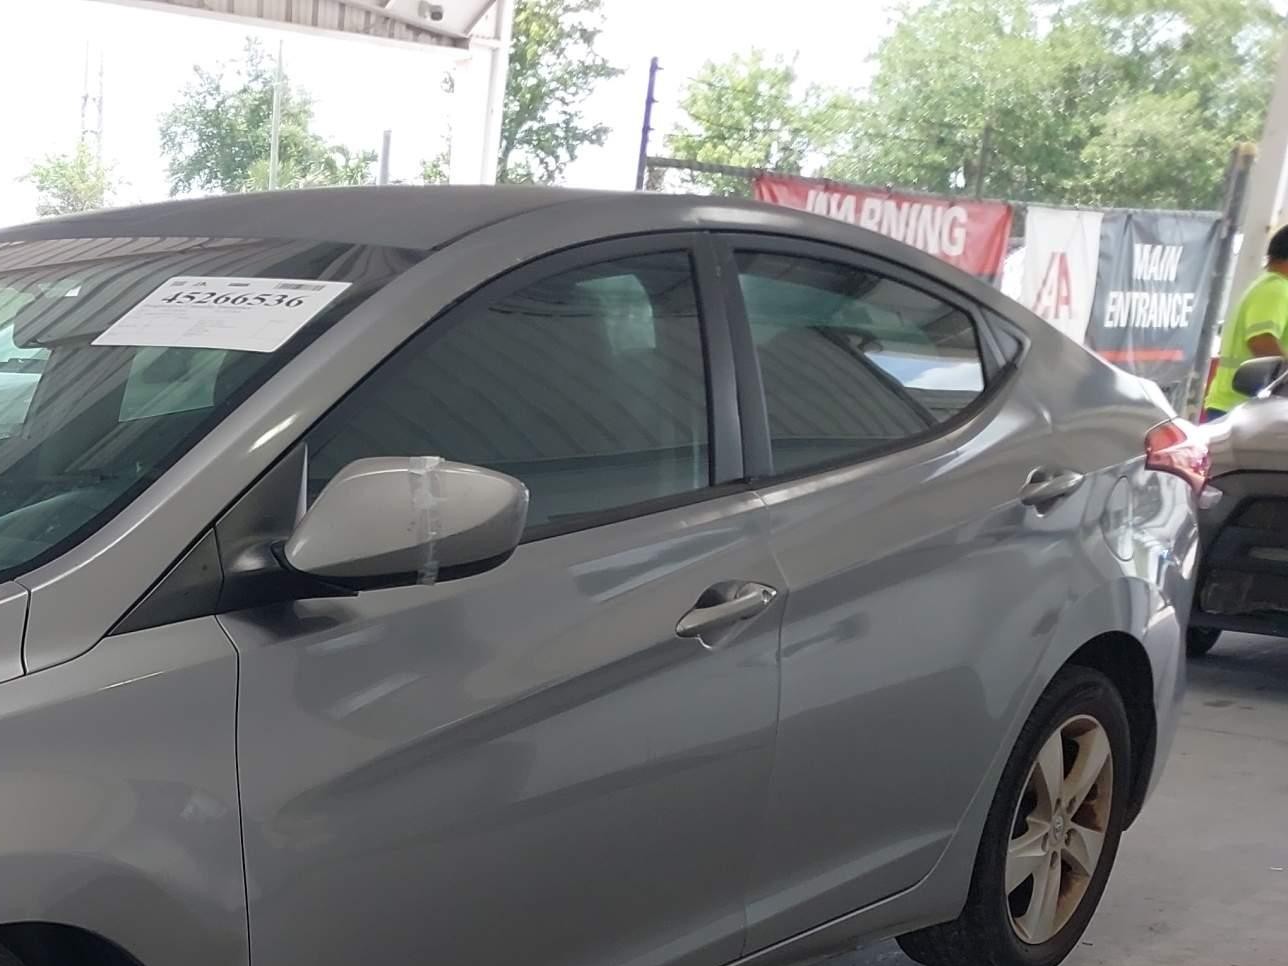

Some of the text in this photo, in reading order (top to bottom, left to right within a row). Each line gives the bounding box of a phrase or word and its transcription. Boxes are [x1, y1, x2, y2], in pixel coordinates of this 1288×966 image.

[1132, 242, 1184, 282] MAIN
[161, 291, 309, 308] 45266536
[1103, 290, 1196, 328] ENTRANCE
